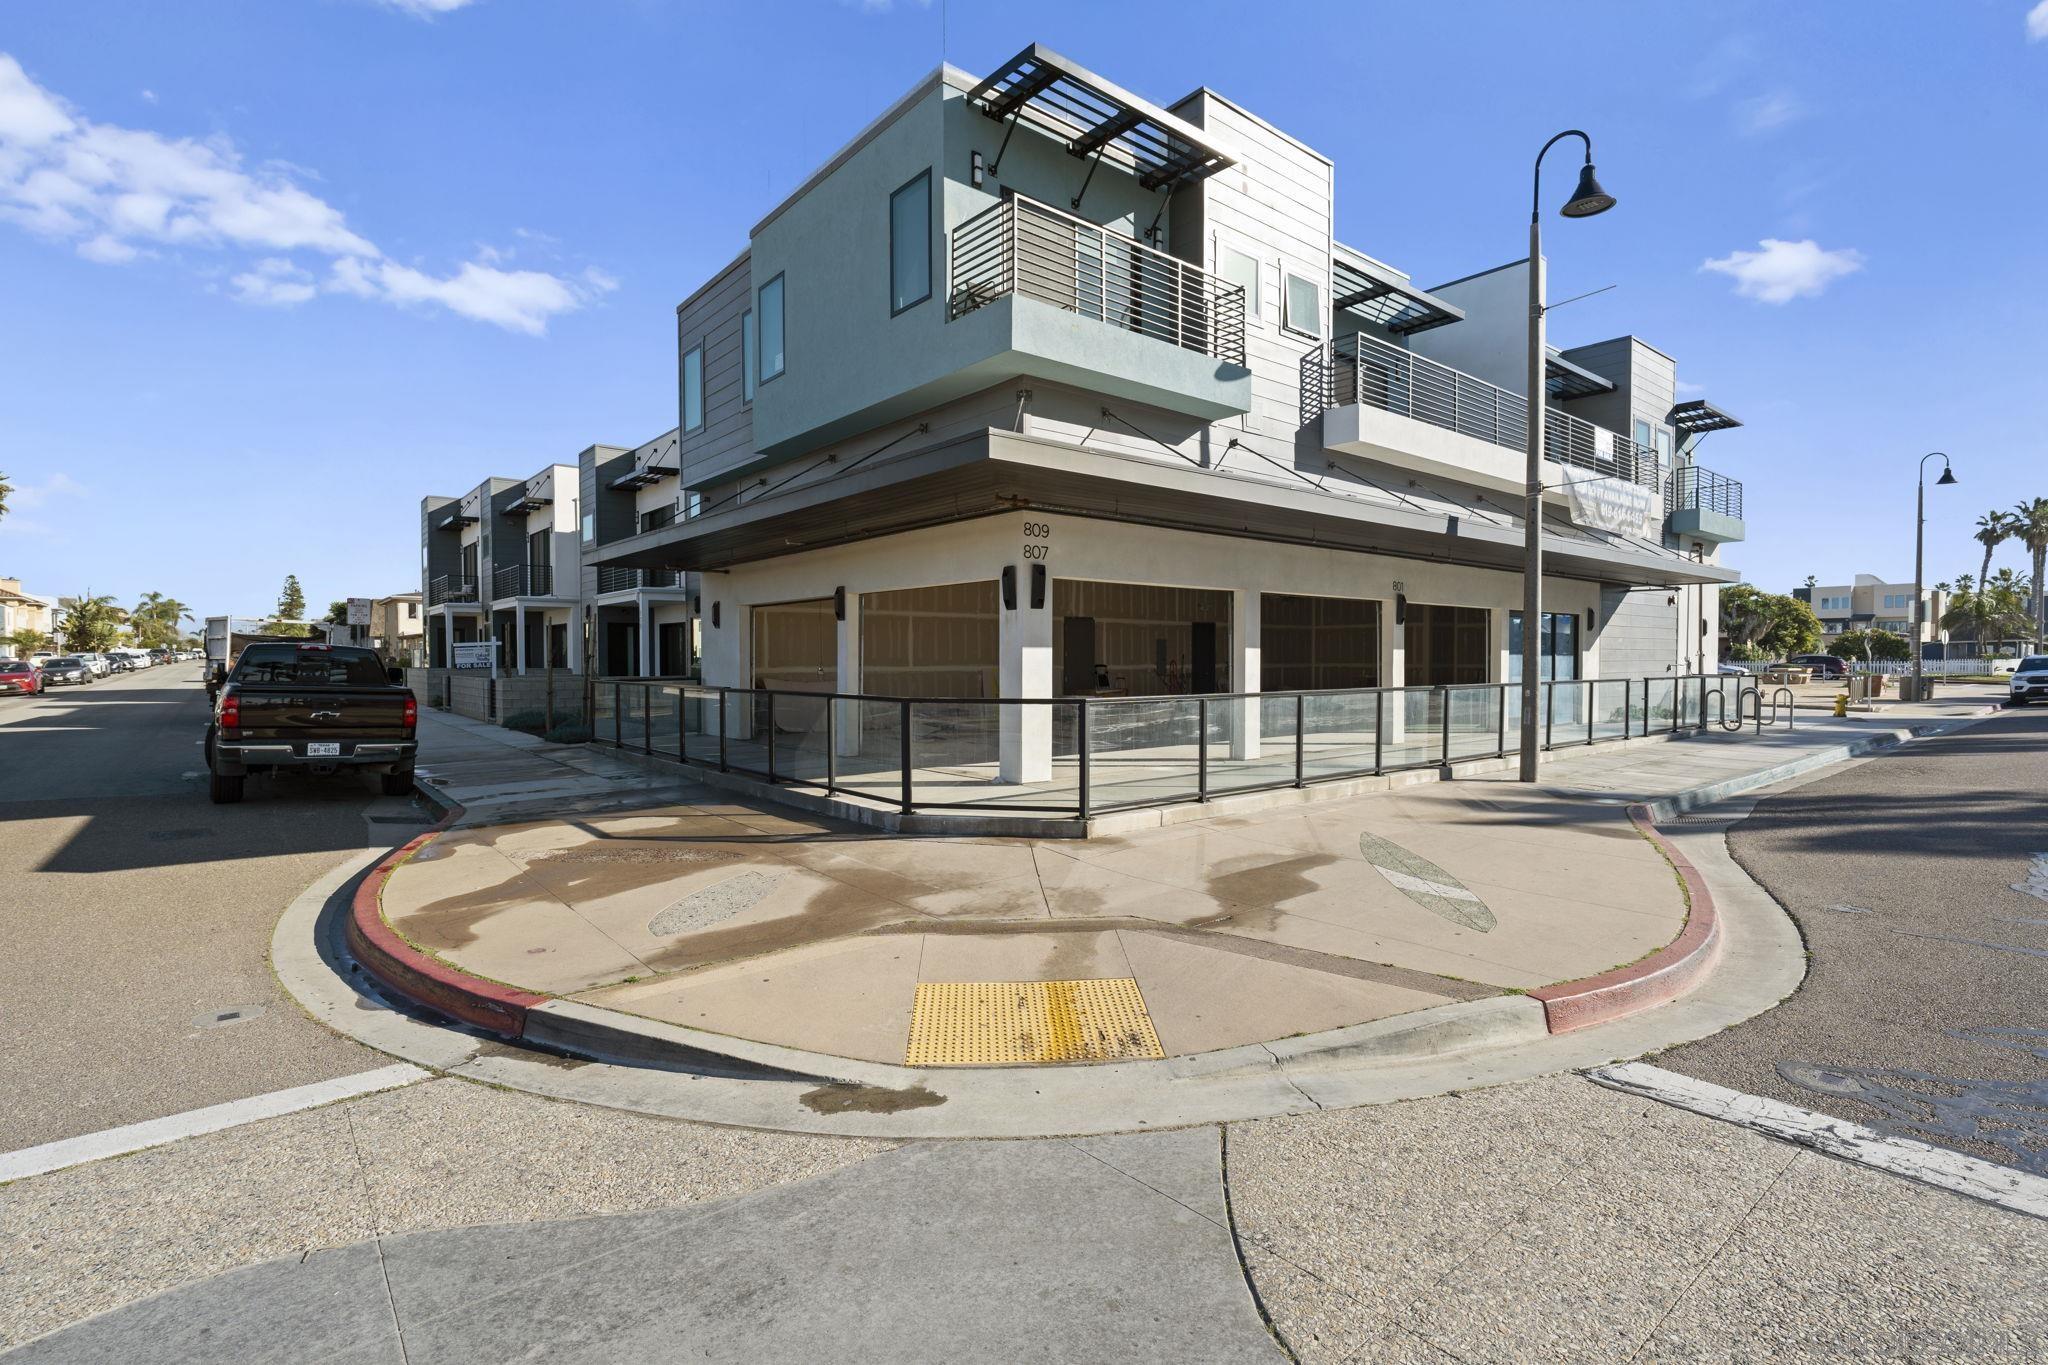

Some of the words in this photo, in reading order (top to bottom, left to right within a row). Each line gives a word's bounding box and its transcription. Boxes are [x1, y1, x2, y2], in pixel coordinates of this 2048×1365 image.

[1023, 522, 1050, 538] 809
[1023, 544, 1049, 560] 807
[1392, 580, 1404, 593] 801
